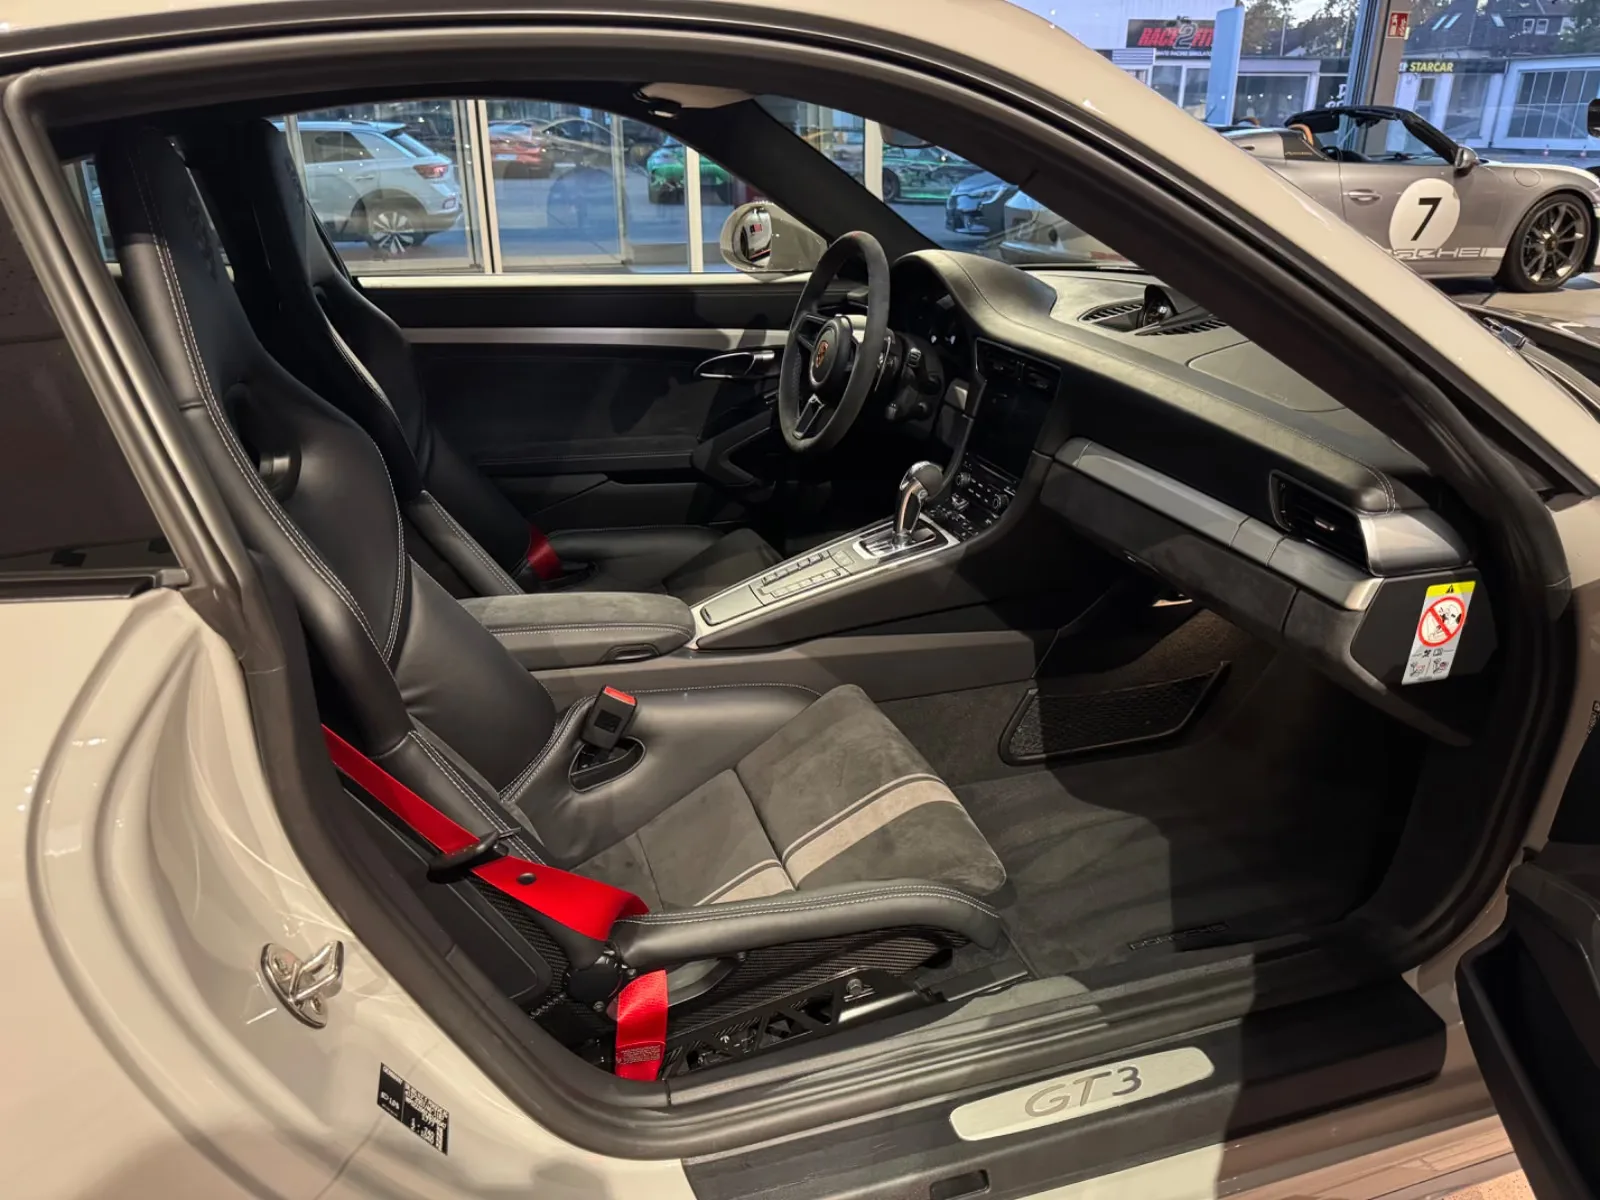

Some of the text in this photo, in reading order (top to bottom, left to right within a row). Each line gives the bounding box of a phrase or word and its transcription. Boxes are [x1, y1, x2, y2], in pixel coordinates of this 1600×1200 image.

[1409, 62, 1454, 73] STARCAR
[1410, 197, 1443, 242] 7
[1024, 1066, 1143, 1118] GT3
